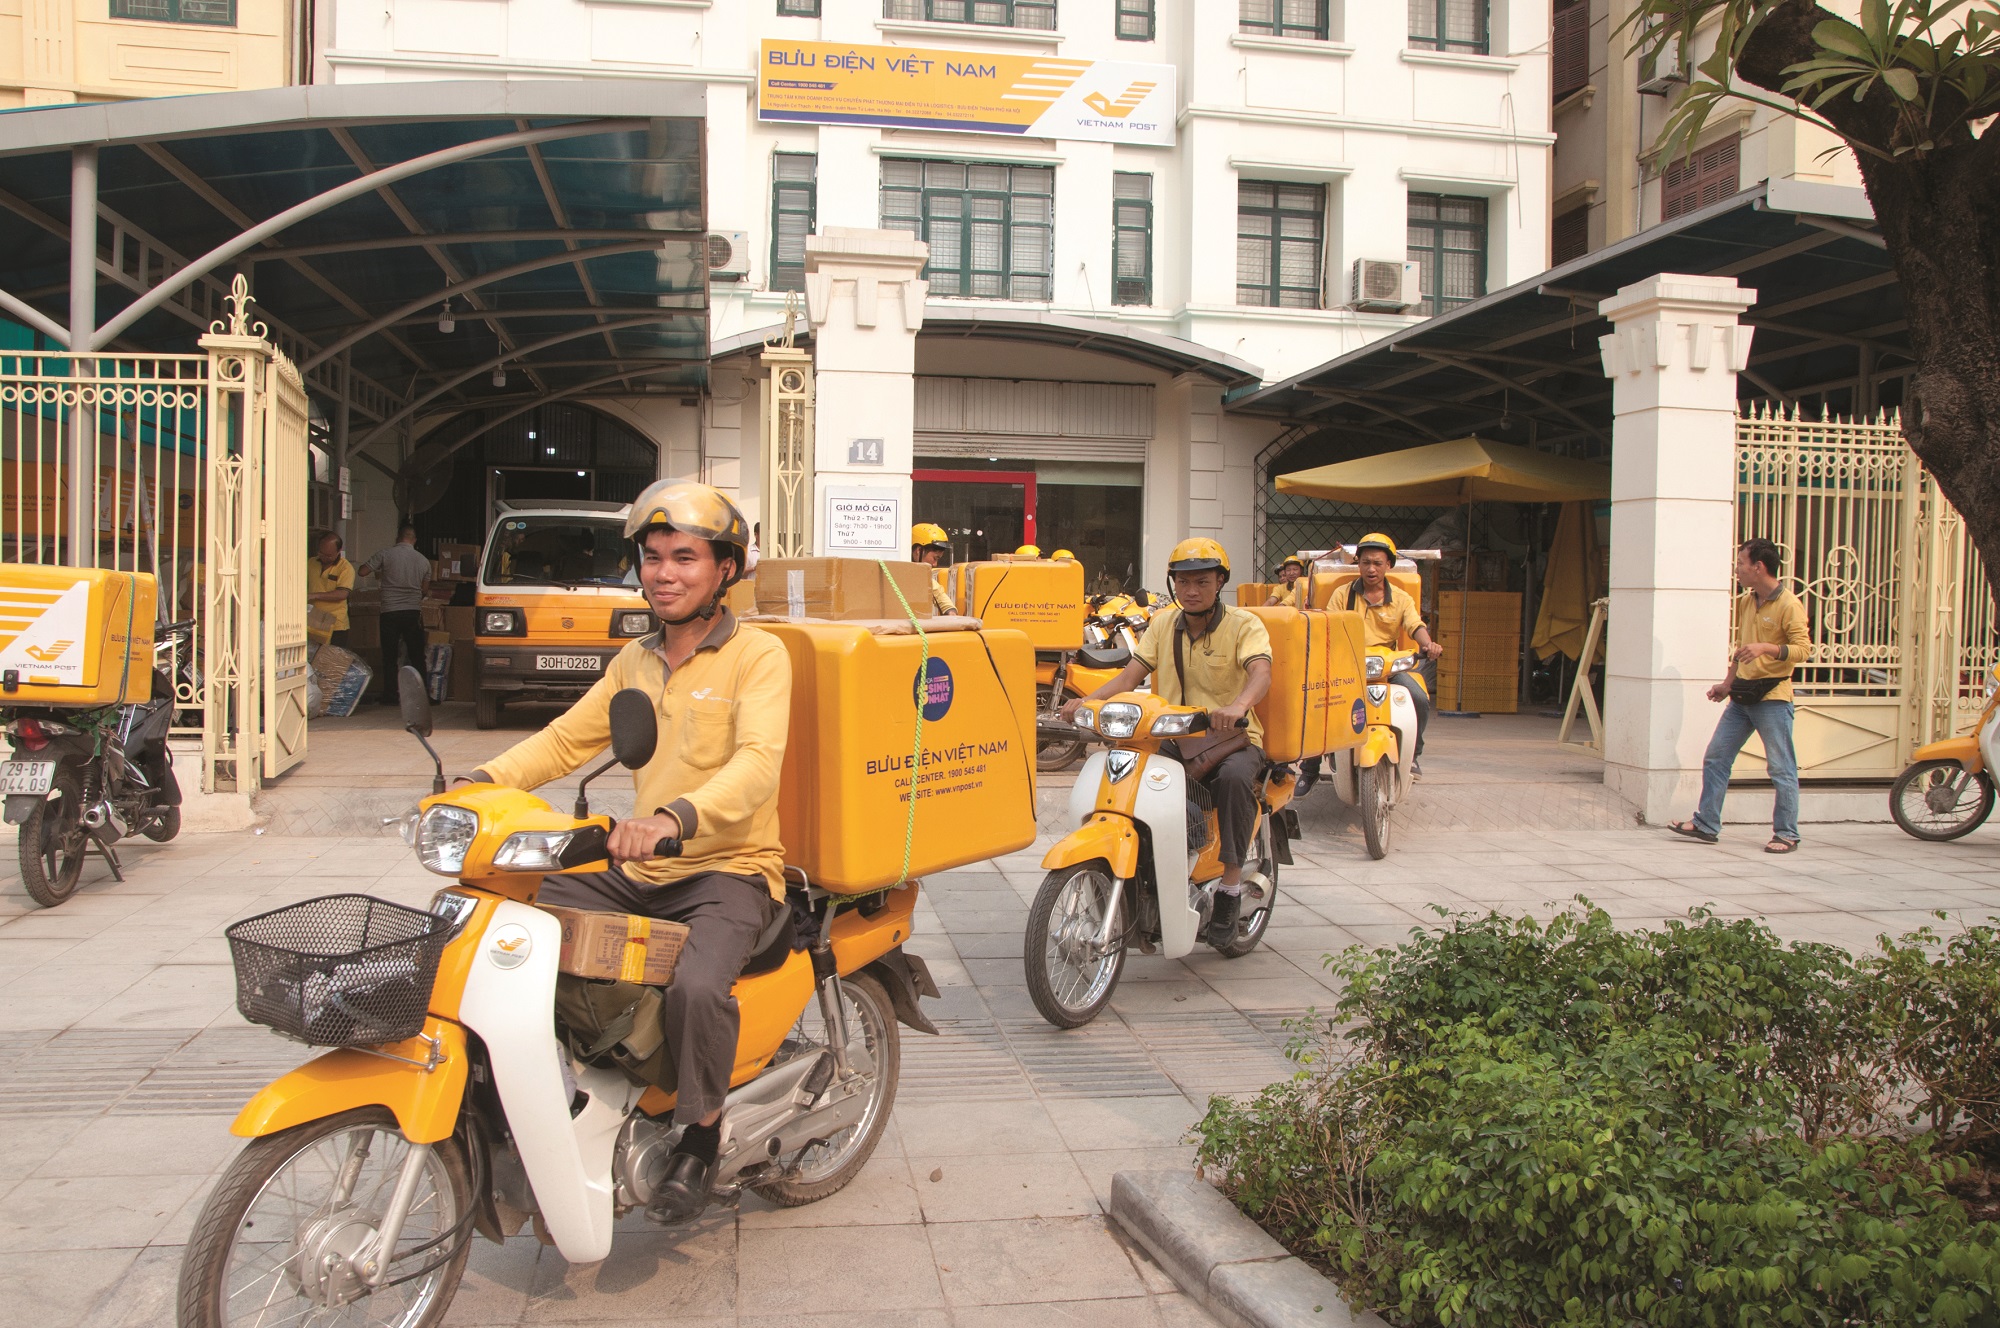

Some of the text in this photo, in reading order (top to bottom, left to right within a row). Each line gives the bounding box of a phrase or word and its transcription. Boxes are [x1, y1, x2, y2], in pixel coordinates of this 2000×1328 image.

[769, 49, 996, 78] BƯU ĐIỆN VIỆT NAM
[1076, 118, 1157, 131] VIETNAM POST
[856, 442, 878, 461] 14
[855, 503, 870, 512] MỞ
[872, 504, 891, 512] CỬA
[1015, 602, 1035, 610] ĐIỆN
[929, 682, 949, 693] SINH
[929, 692, 949, 704] NHẬT
[867, 755, 900, 775] BƯU
[945, 743, 975, 764] VIỆT
[979, 740, 1008, 757] NAM
[7, 763, 46, 776] 29-B1
[948, 768, 963, 779] 1900
[964, 766, 975, 776] 545
[976, 764, 986, 774] 481
[0, 778, 47, 792] 044.09
[899, 780, 983, 802] WESITE: www.vnpost.vn
